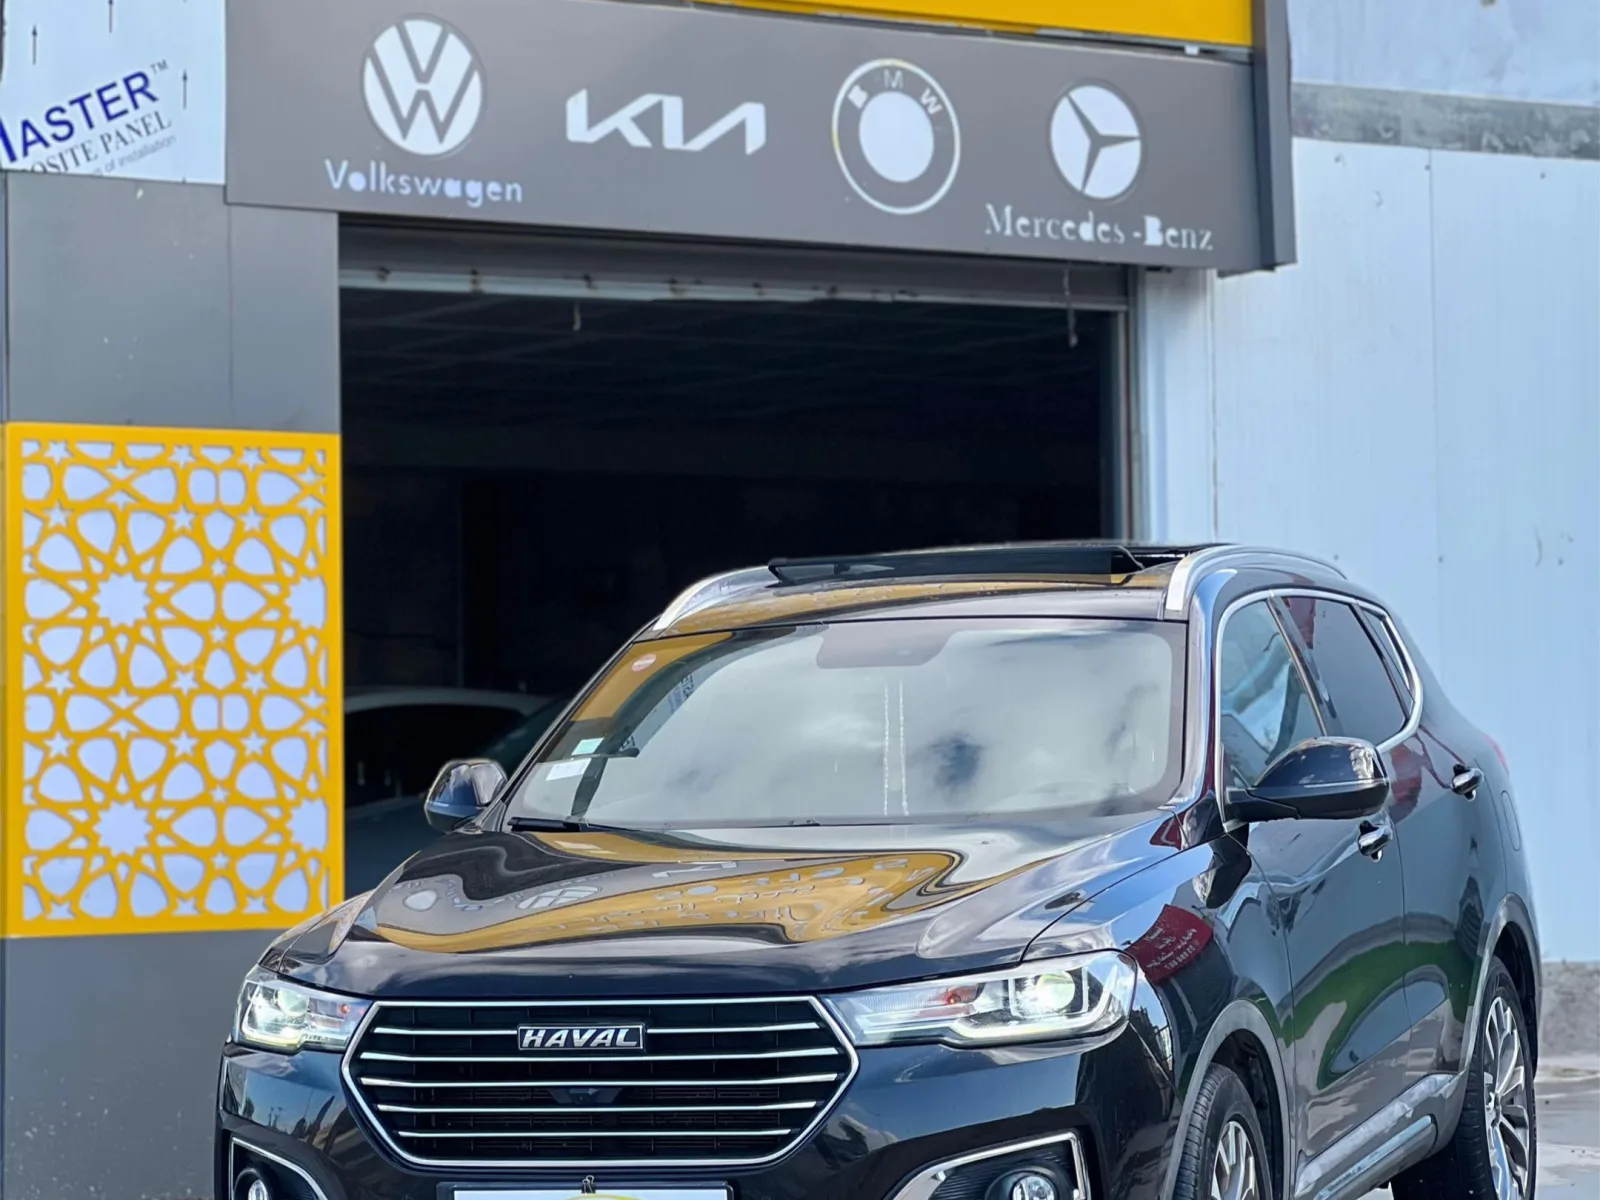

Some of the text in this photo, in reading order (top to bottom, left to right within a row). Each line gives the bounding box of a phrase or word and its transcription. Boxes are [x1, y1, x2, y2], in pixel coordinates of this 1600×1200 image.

[30, 110, 172, 173] OSITE PANEL
[566, 89, 766, 155] KIA
[324, 159, 523, 207] Volkswagen
[522, 1028, 638, 1048] HAVAL
